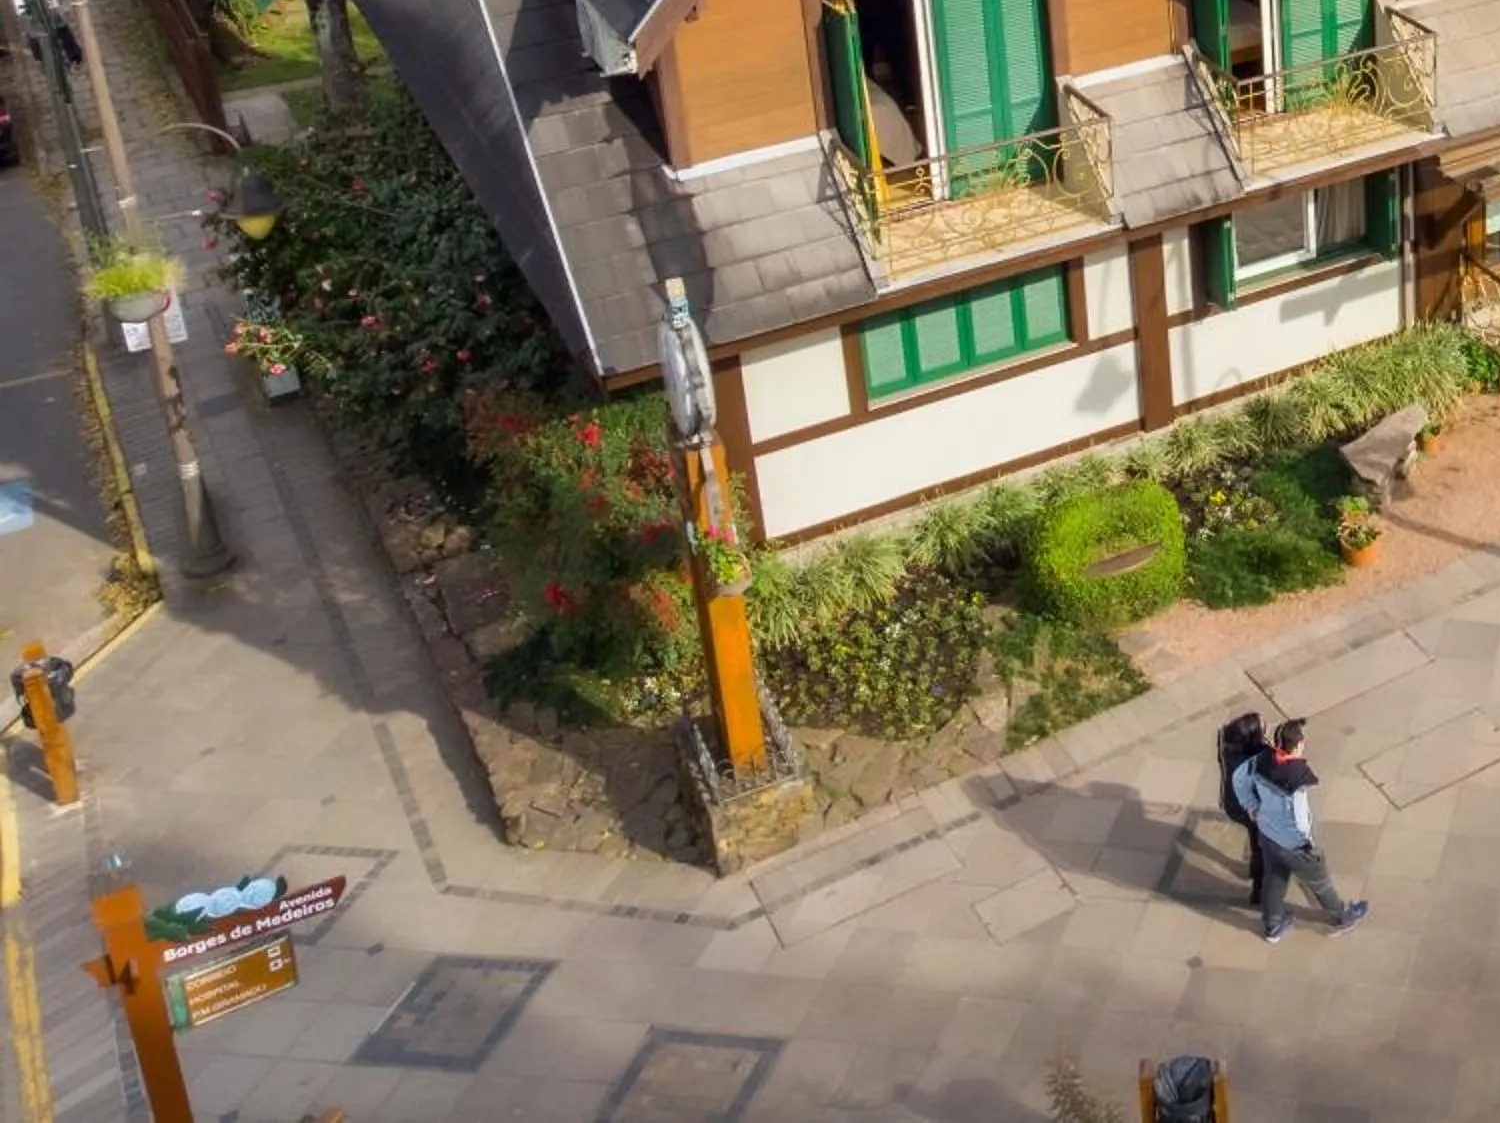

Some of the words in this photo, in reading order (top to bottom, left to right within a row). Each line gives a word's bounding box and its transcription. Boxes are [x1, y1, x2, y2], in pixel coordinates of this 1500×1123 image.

[279, 885, 333, 911] Avenida
[163, 932, 227, 963] Borges
[230, 925, 253, 940] de
[255, 897, 336, 931] Medeiros
